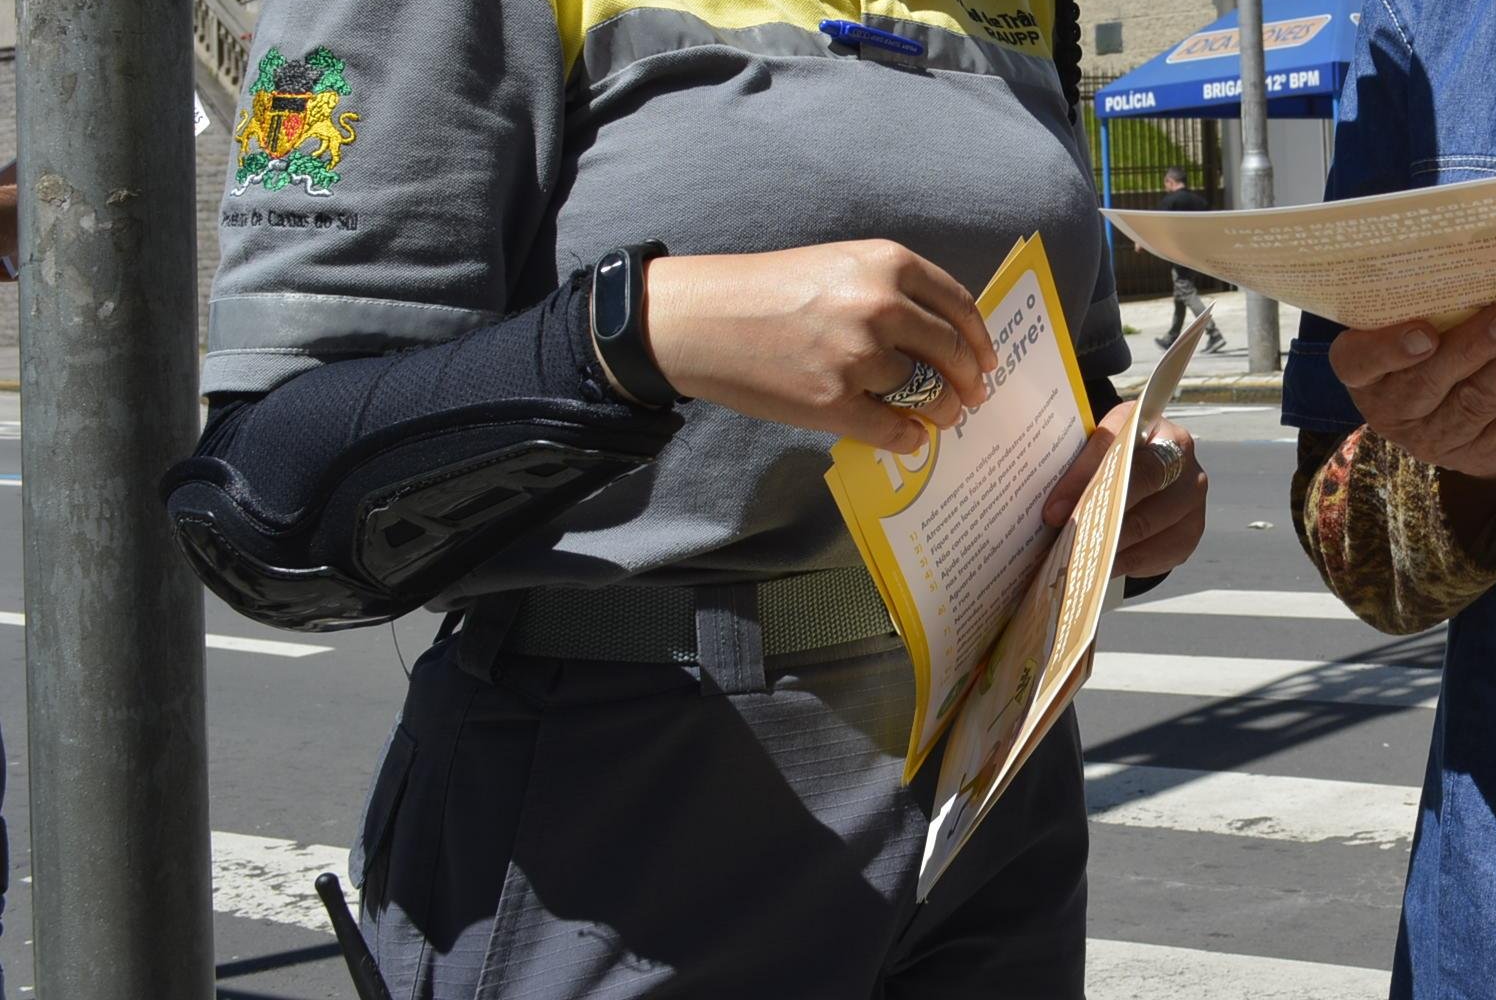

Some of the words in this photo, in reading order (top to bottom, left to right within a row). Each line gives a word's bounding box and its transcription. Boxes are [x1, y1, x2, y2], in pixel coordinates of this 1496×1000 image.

[984, 26, 1040, 46] RAUPP
[1105, 91, 1156, 112] POLÍCIA
[1289, 70, 1319, 88] BPM
[1026, 294, 1036, 310] o
[953, 314, 1045, 440] pdestre:
[920, 506, 939, 530] Ande
[939, 481, 964, 511] sempre
[925, 504, 958, 543] Atravesse
[968, 472, 986, 497] faixa
[987, 462, 996, 476] de
[996, 431, 1025, 468] pedestres
[1025, 420, 1034, 433] ou
[930, 531, 949, 556] Fique
[949, 520, 960, 534] em
[960, 498, 980, 522] locais
[980, 479, 997, 501] onde
[1016, 446, 1026, 460] ver
[1032, 429, 1041, 442] ser
[940, 554, 960, 580] Ajude
[1014, 465, 1037, 498] pessoas
[1037, 450, 1051, 468] com
[935, 547, 950, 568] Não
[978, 481, 1011, 520] atravessar
[948, 567, 976, 604] Aguarde
[982, 537, 1003, 565] ônibus
[1004, 521, 1016, 539] sair
[957, 537, 989, 577] travessias
